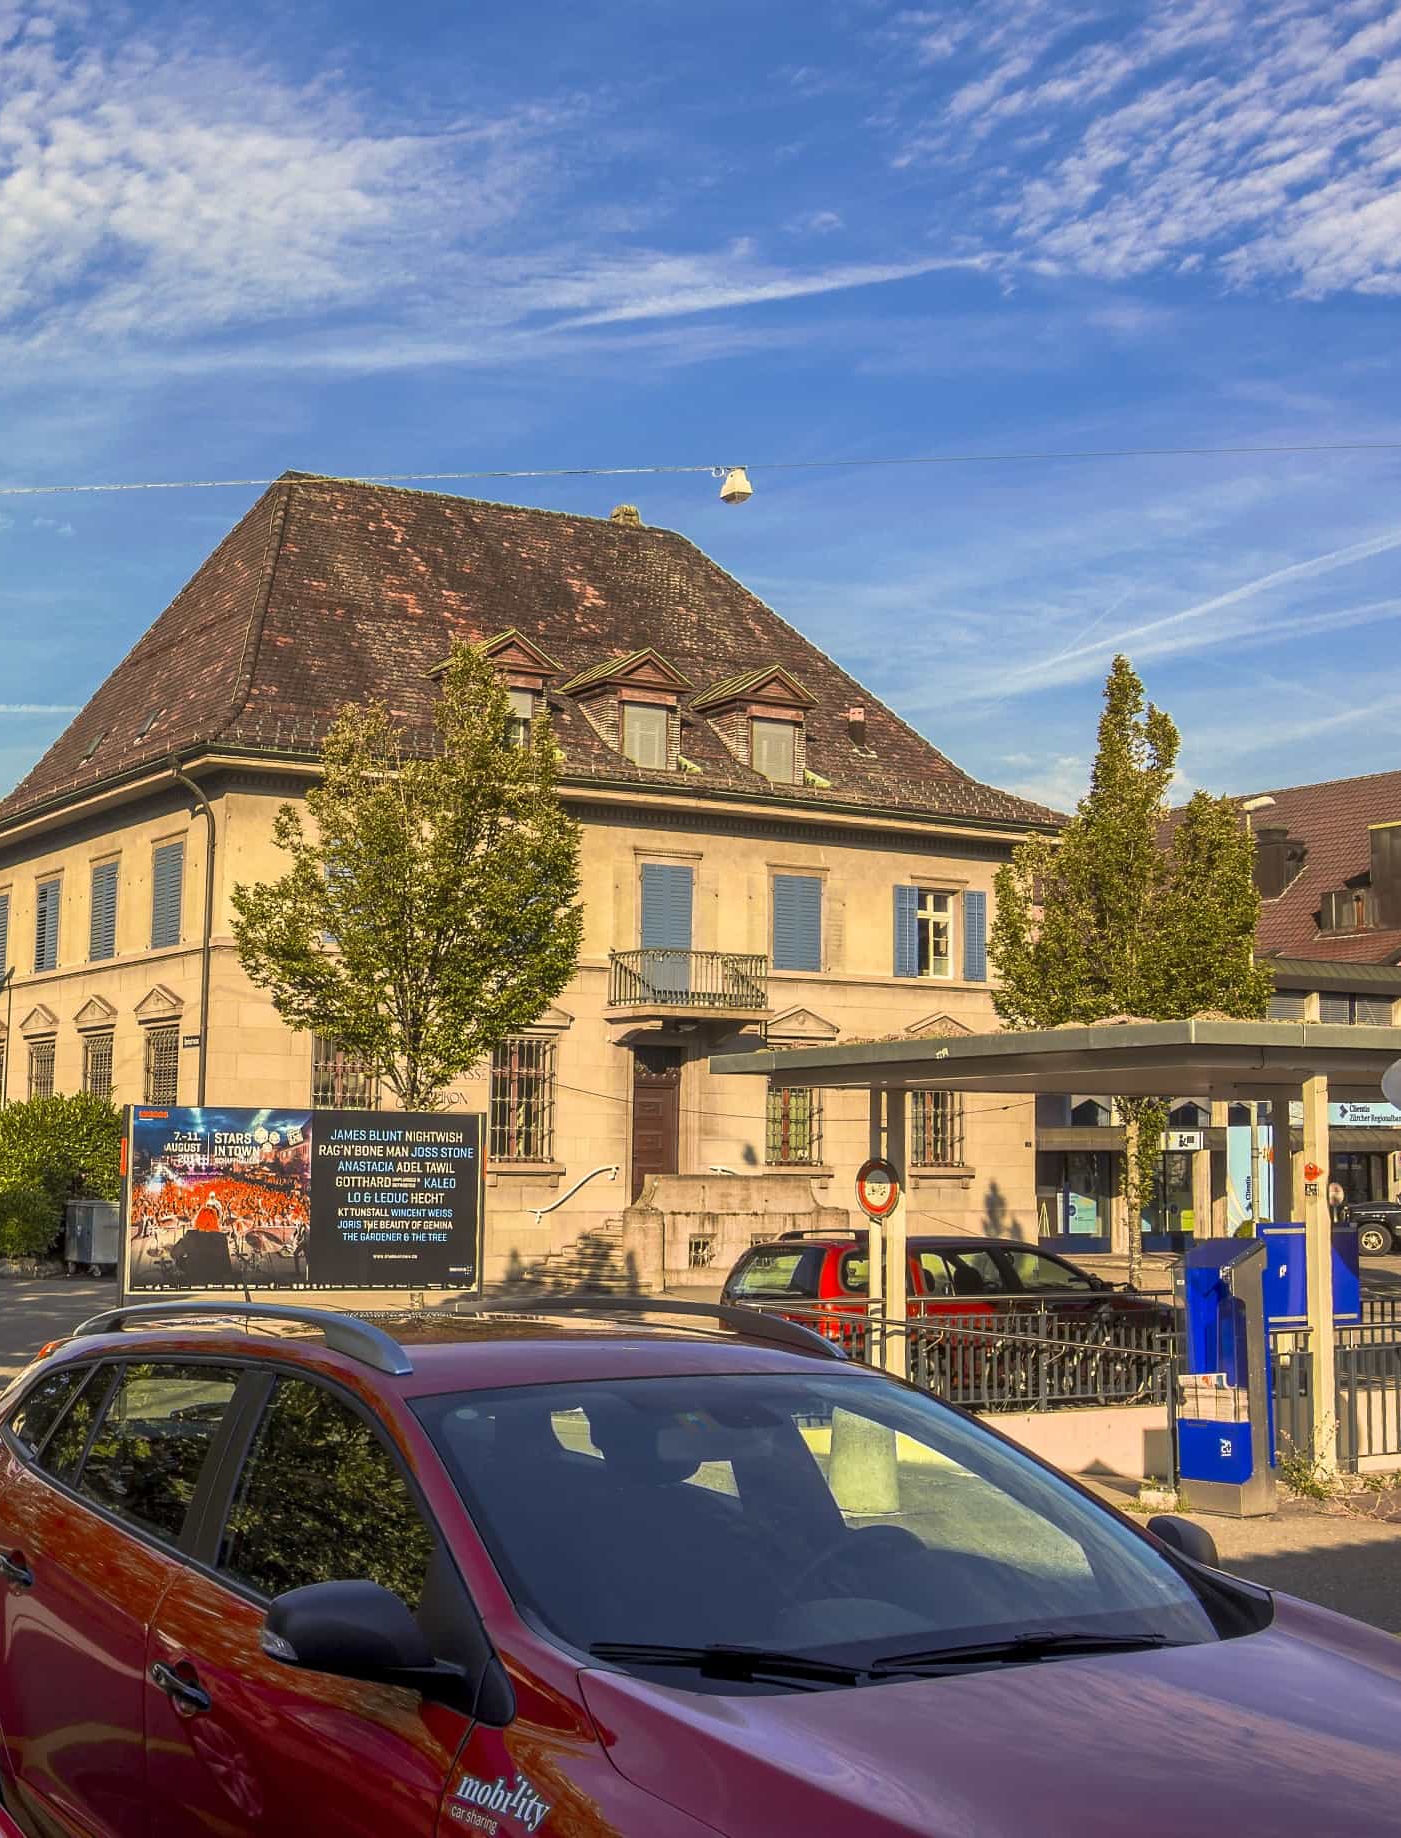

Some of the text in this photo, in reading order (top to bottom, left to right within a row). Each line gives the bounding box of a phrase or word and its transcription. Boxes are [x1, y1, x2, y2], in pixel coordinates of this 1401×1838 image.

[214, 1132, 251, 1145] STARS
[330, 1129, 463, 1143] JAMES BLUNT NIGHTWISH
[166, 1142, 201, 1153] AUGUST
[214, 1145, 260, 1157] IN TOWN
[386, 1146, 409, 1157] MAN
[411, 1147, 439, 1158] JOSS
[440, 1147, 474, 1159] STONE
[337, 1160, 455, 1174] ANASTACIA ADEL TAWIL
[335, 1176, 392, 1188] GOTTHARD
[424, 1177, 456, 1189] KALEO
[347, 1191, 445, 1204] LO & LEDUC HECHT
[337, 1207, 453, 1218] KT TUNSTALL WINCENT WEISS
[337, 1220, 453, 1230] JORIS THE BEAUTY OF GEMINA
[343, 1232, 447, 1242] THE GARDENER & THE TREE
[456, 1775, 551, 1832] mobility
[451, 1805, 498, 1836] car sharing
